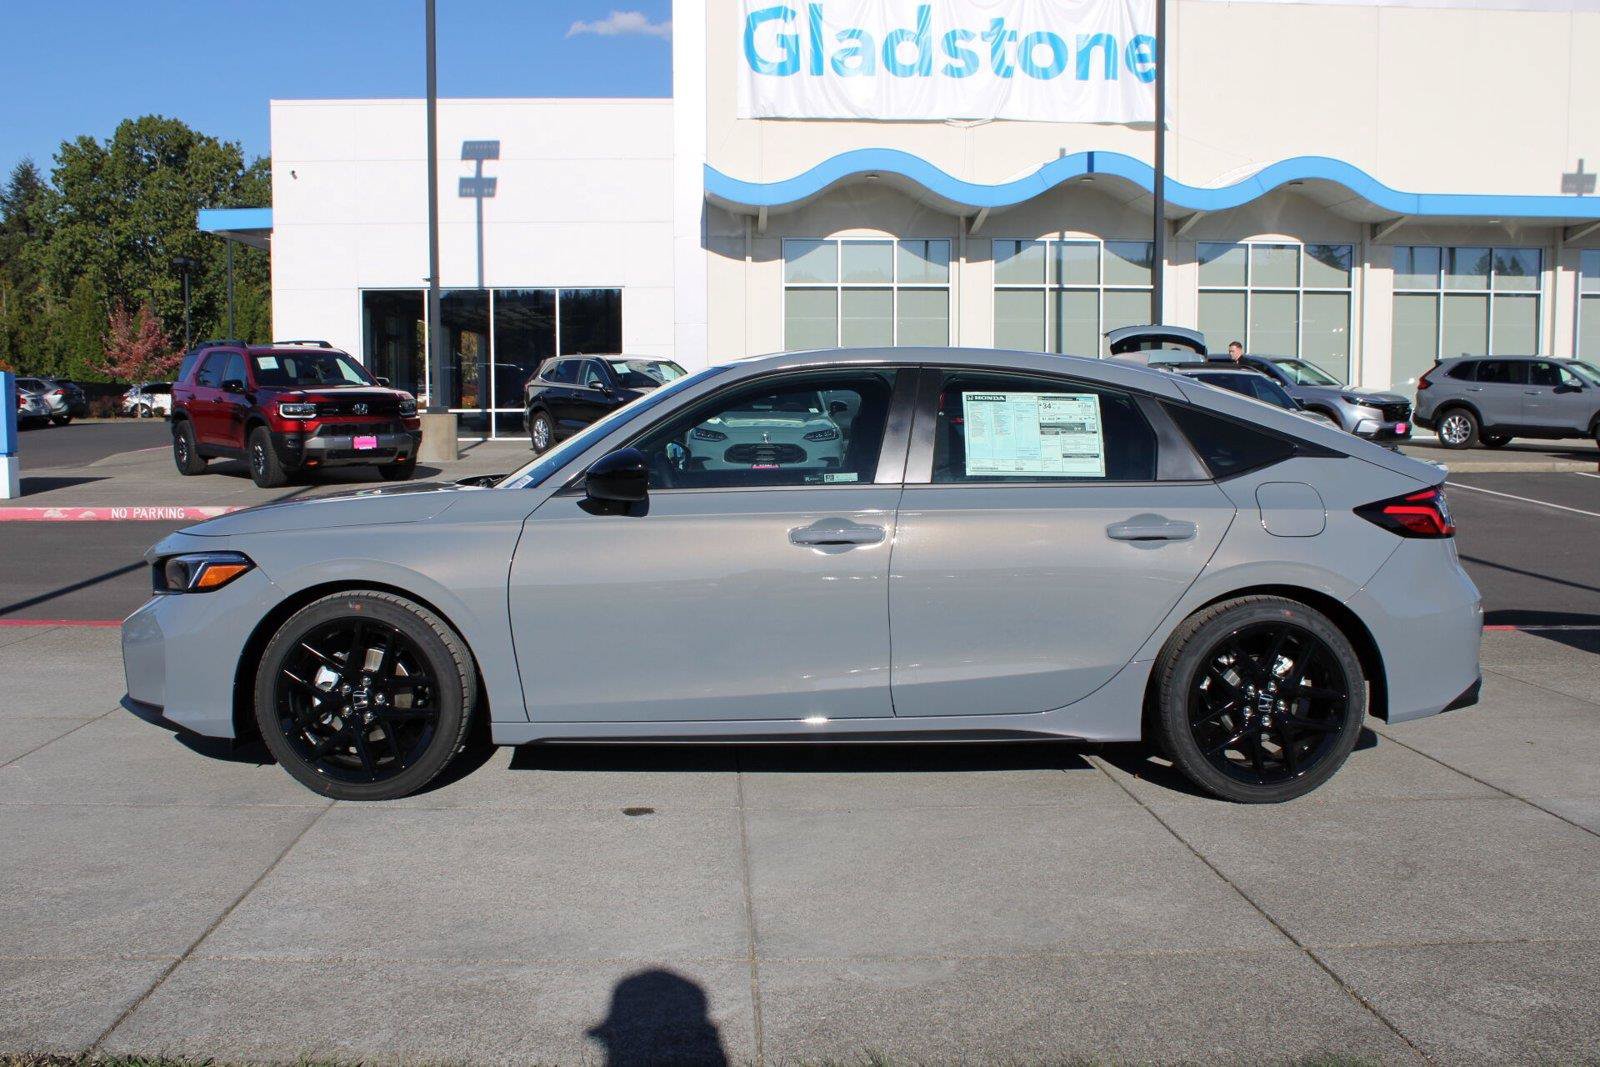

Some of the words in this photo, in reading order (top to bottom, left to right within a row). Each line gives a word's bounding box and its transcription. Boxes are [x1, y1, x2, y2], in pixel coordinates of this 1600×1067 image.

[743, 3, 1157, 83] Gladstone
[111, 507, 128, 519] NO
[133, 507, 185, 519] PARKING
